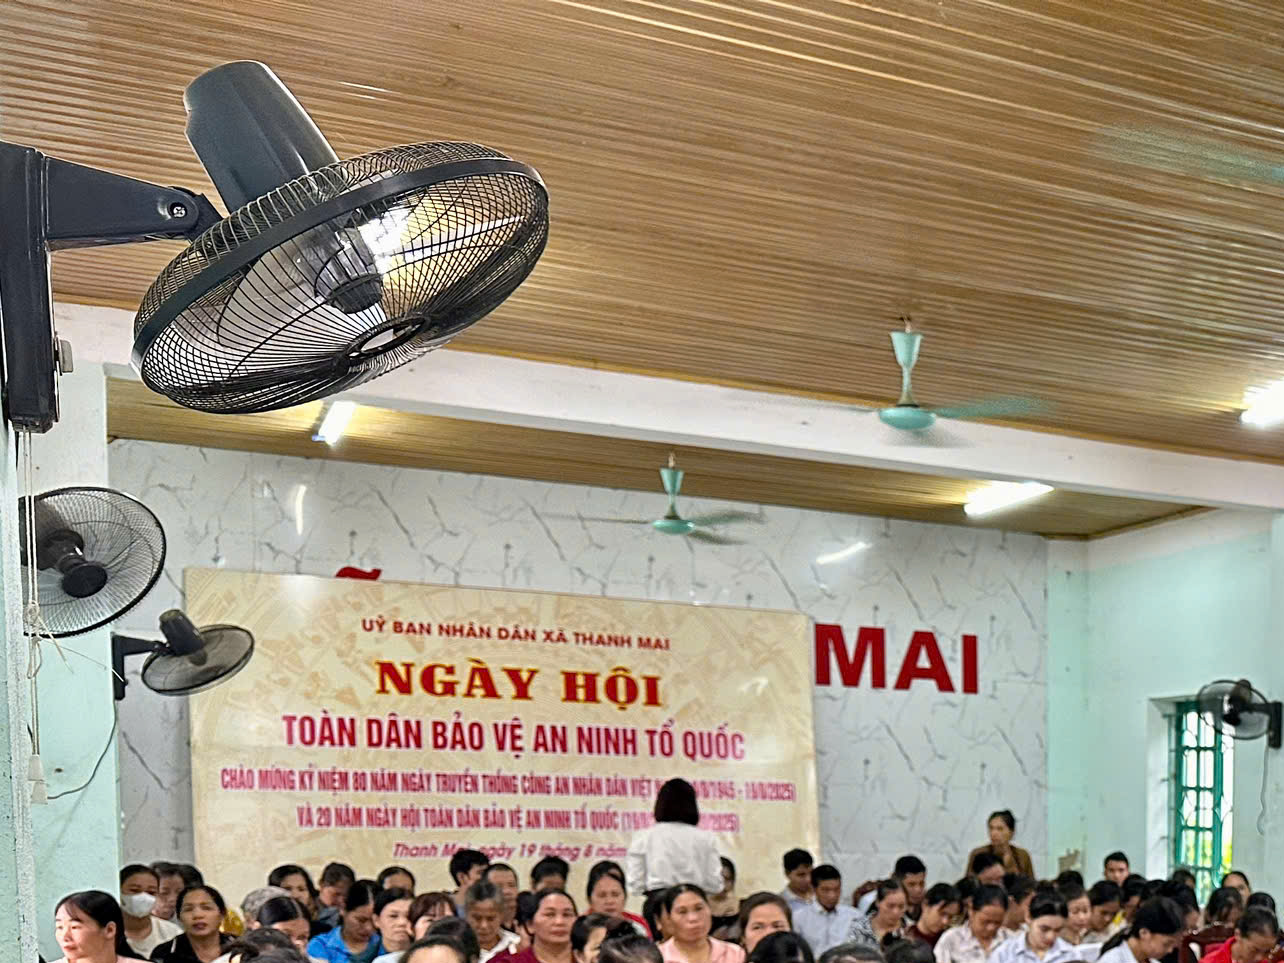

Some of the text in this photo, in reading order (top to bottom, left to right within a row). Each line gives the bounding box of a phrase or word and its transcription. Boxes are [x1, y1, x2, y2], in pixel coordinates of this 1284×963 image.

[392, 619, 432, 636] BAN
[438, 620, 491, 639] NHÂN
[497, 623, 537, 641] DÂN
[542, 629, 568, 644] XÃ
[573, 631, 632, 649] THANH
[637, 636, 670, 651] MAI
[814, 623, 978, 694] MAI
[374, 656, 663, 711] NGÀY HỘI
[282, 708, 745, 762] TOÀN DÂN BẢO VỆ AN NINH TỔ QUỐC
